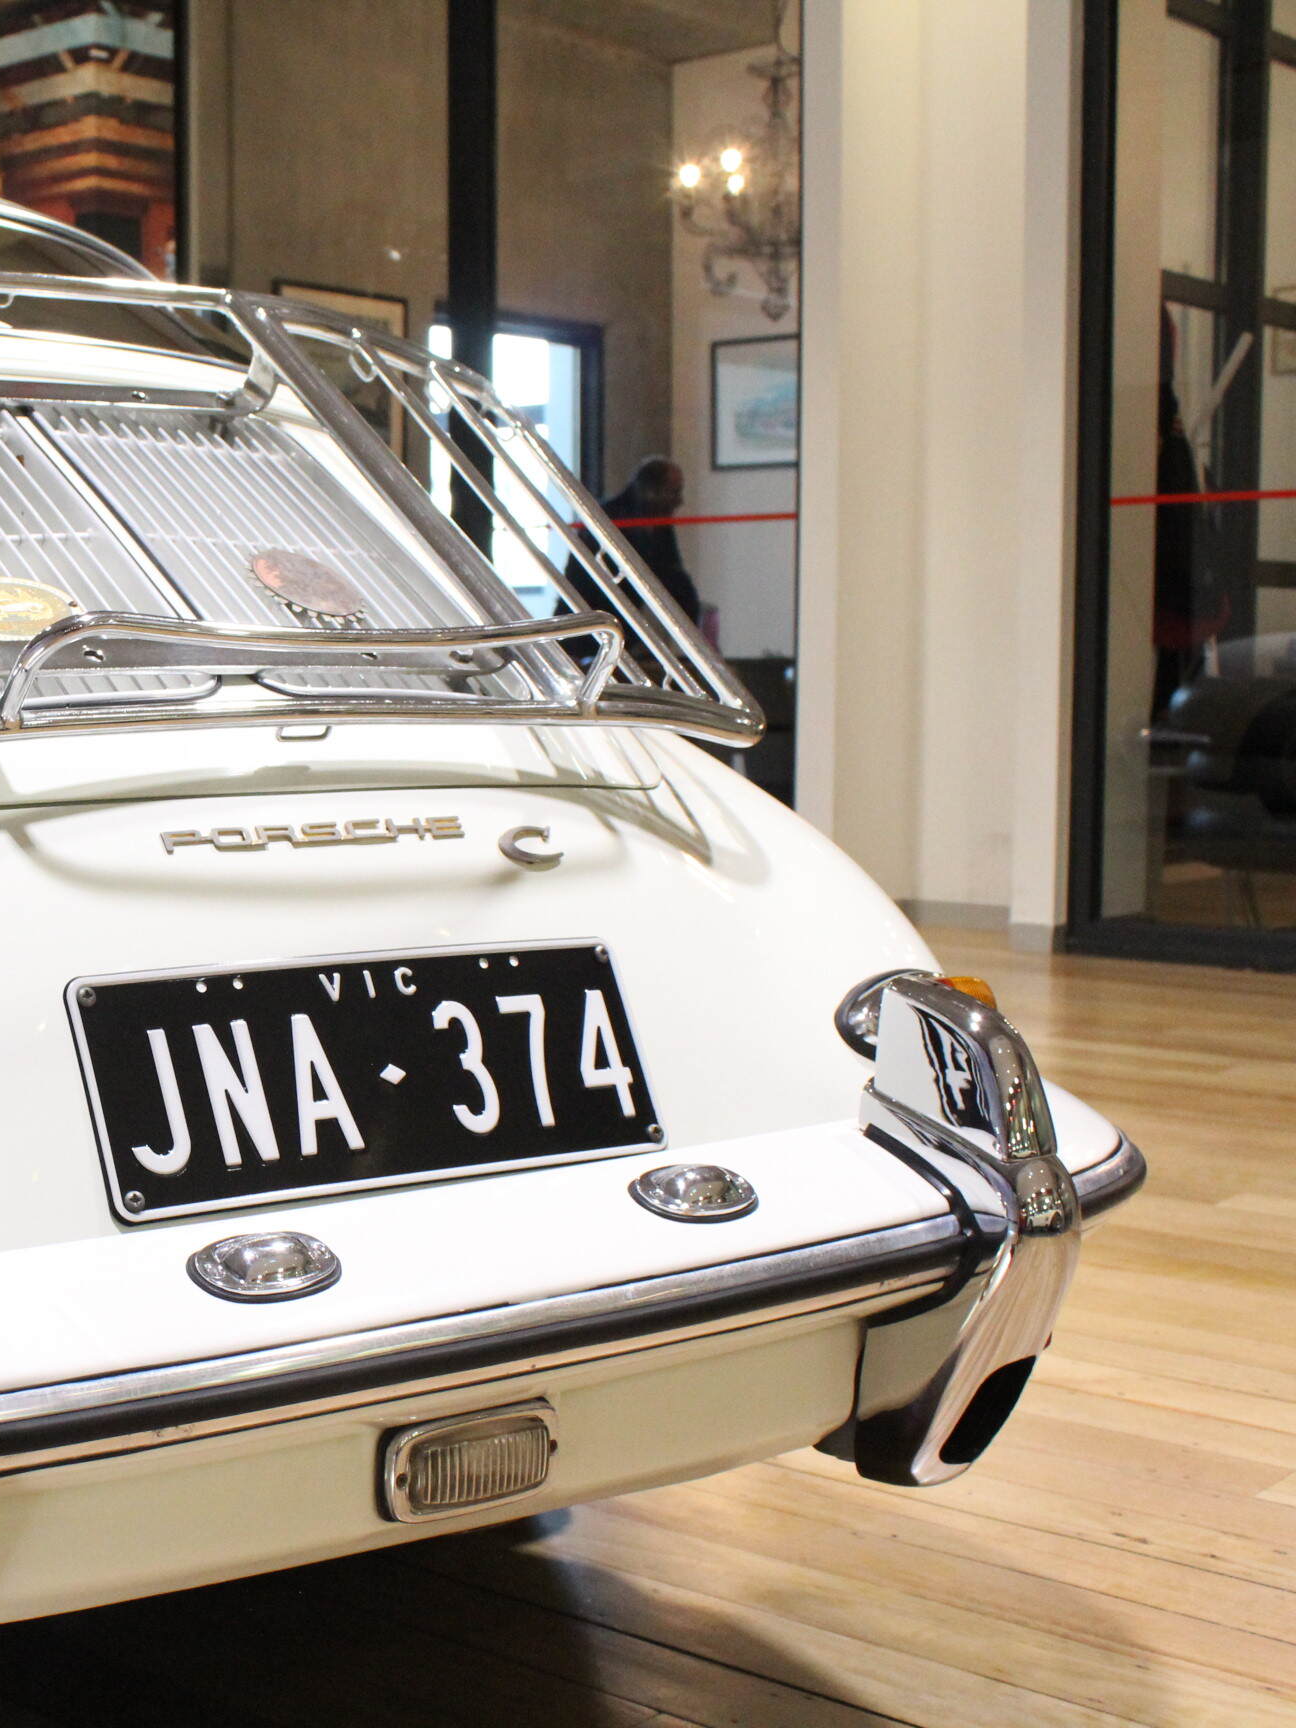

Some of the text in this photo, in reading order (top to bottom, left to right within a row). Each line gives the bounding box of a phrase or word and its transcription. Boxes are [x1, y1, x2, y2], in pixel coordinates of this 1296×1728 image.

[160, 815, 564, 872] PORSCHE C
[317, 966, 418, 1003] VIC
[131, 988, 636, 1176] JNA 374
